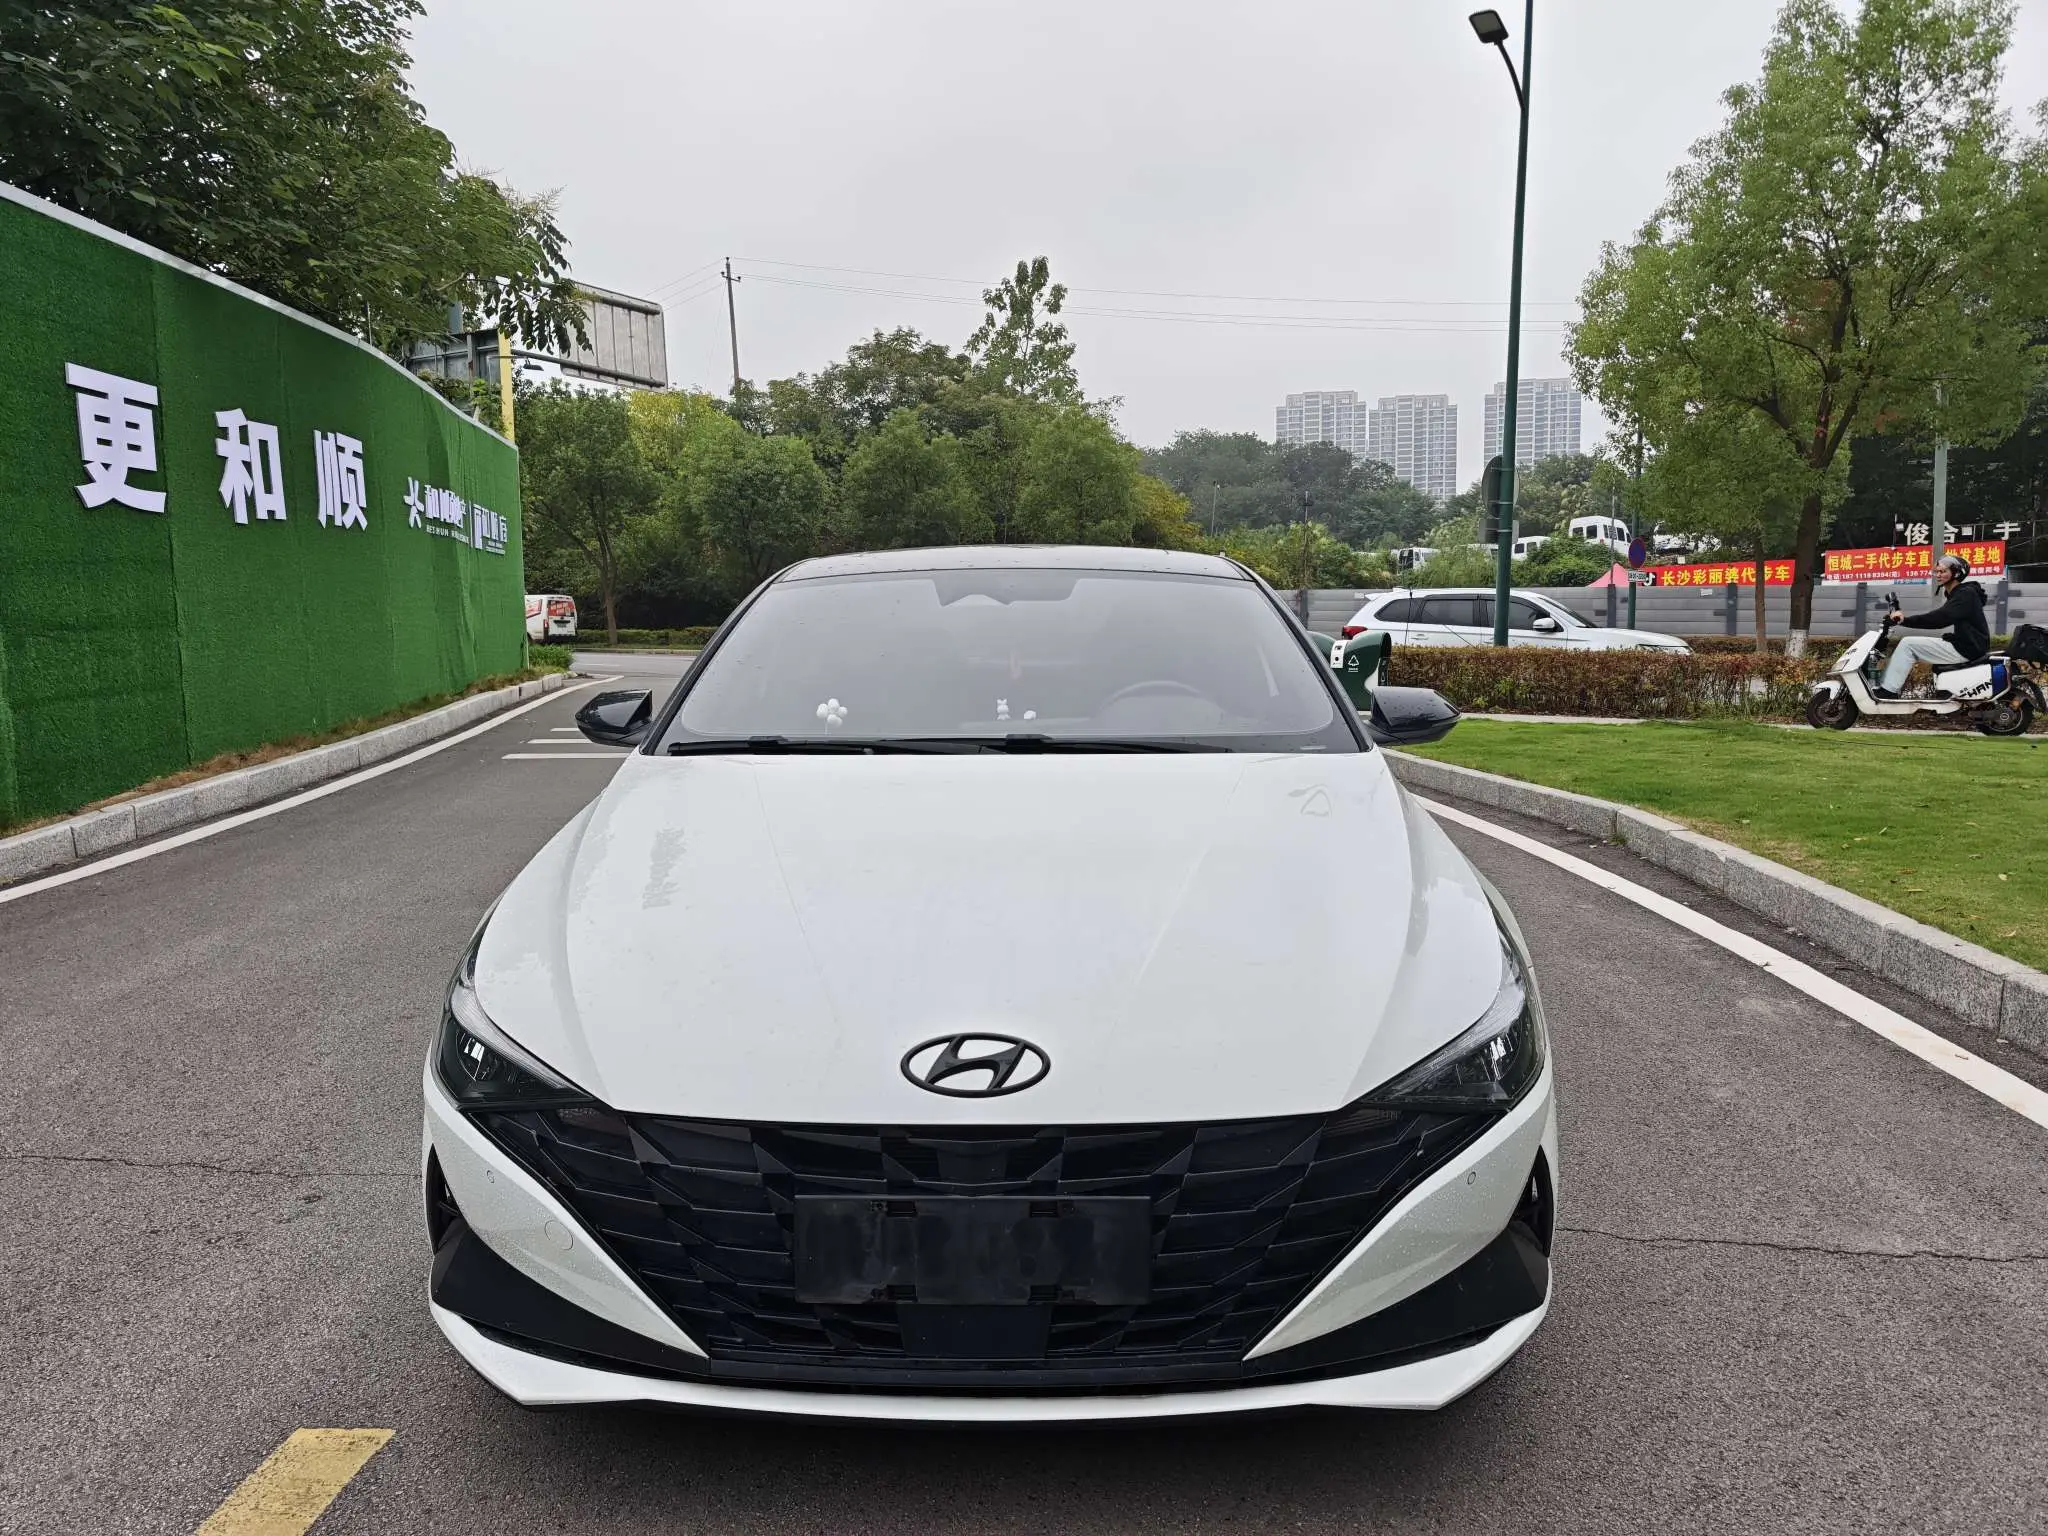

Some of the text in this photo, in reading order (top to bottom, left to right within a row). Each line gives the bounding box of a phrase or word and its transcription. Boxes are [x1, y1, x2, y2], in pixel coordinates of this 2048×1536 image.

[64, 361, 368, 532] 更和顺
[1828, 546, 2001, 571] 恒城二手代步车直批发基地
